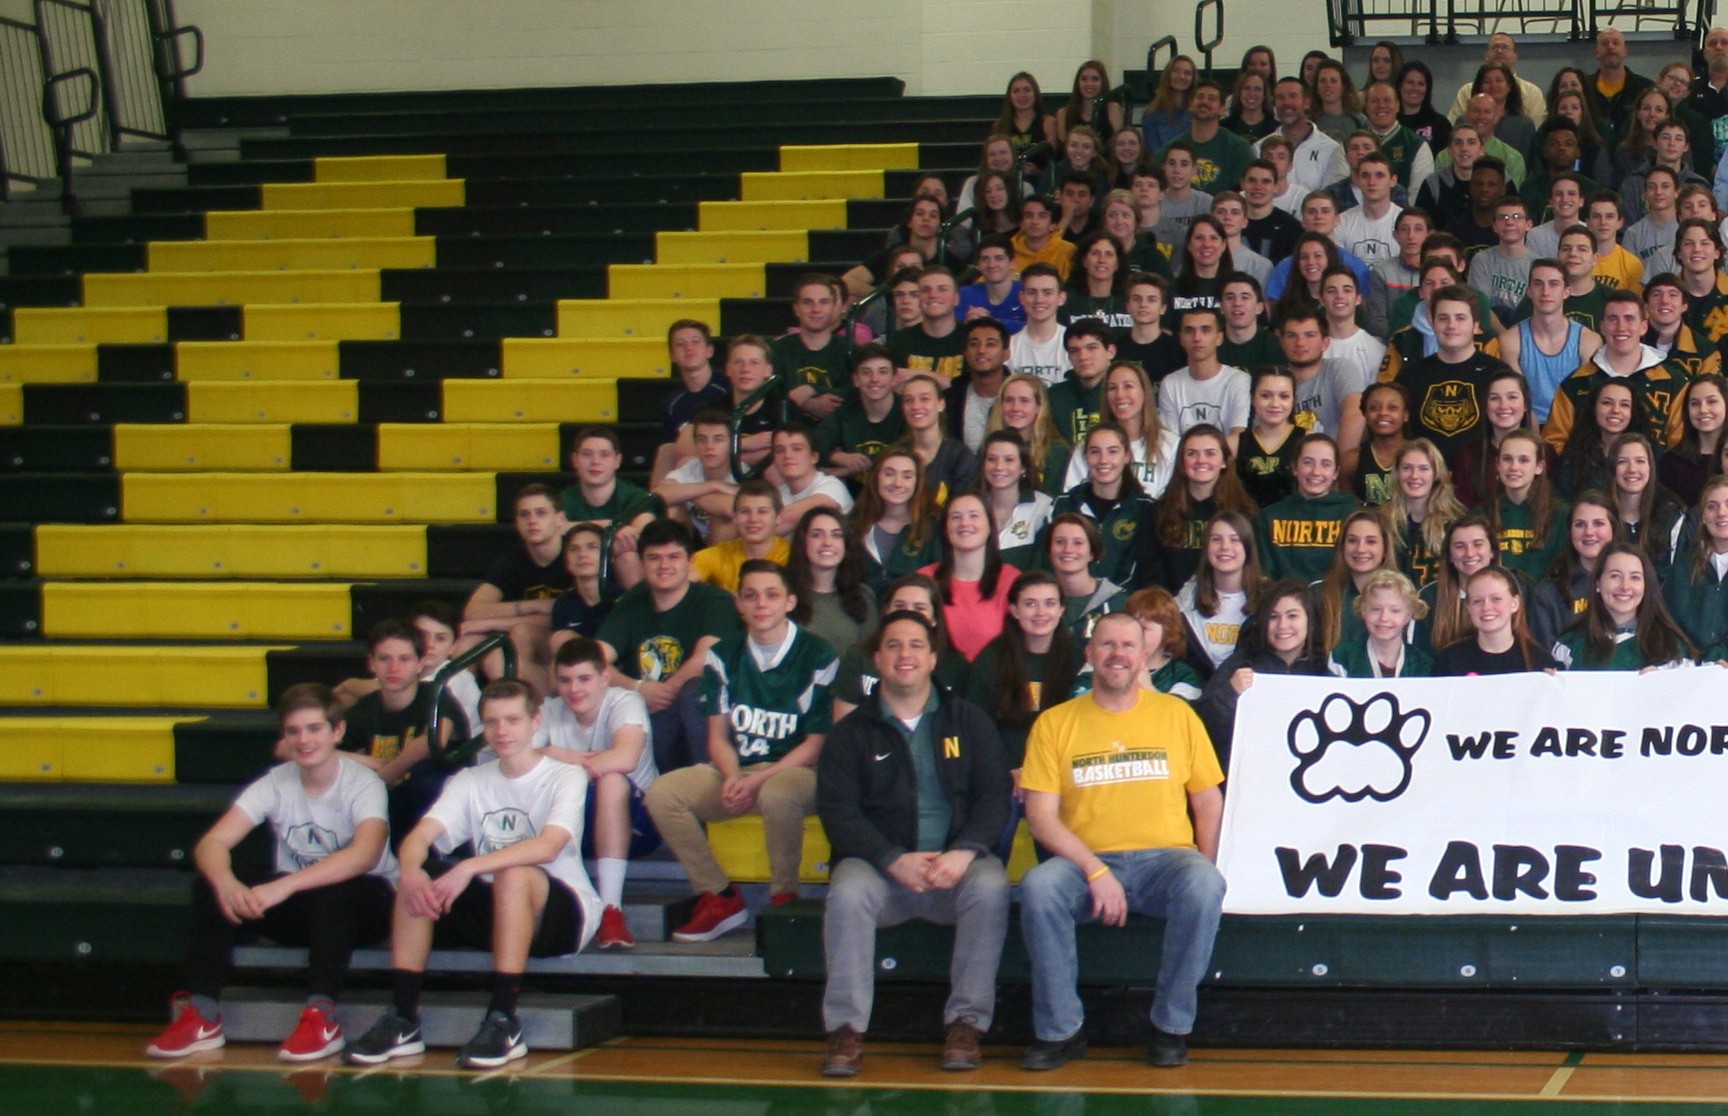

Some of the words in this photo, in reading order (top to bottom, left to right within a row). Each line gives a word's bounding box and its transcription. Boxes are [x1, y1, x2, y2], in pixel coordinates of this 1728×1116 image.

[1444, 384, 1457, 397] N
[1195, 407, 1207, 421] N
[1271, 518, 1342, 545] NORTH
[943, 736, 961, 760] N
[1447, 732, 1518, 760] WE
[1531, 728, 1625, 758] ARE
[1073, 759, 1170, 785] BASKETBALL
[502, 813, 517, 831] N
[1276, 844, 1407, 899] WE
[1429, 842, 1601, 901] ARE
